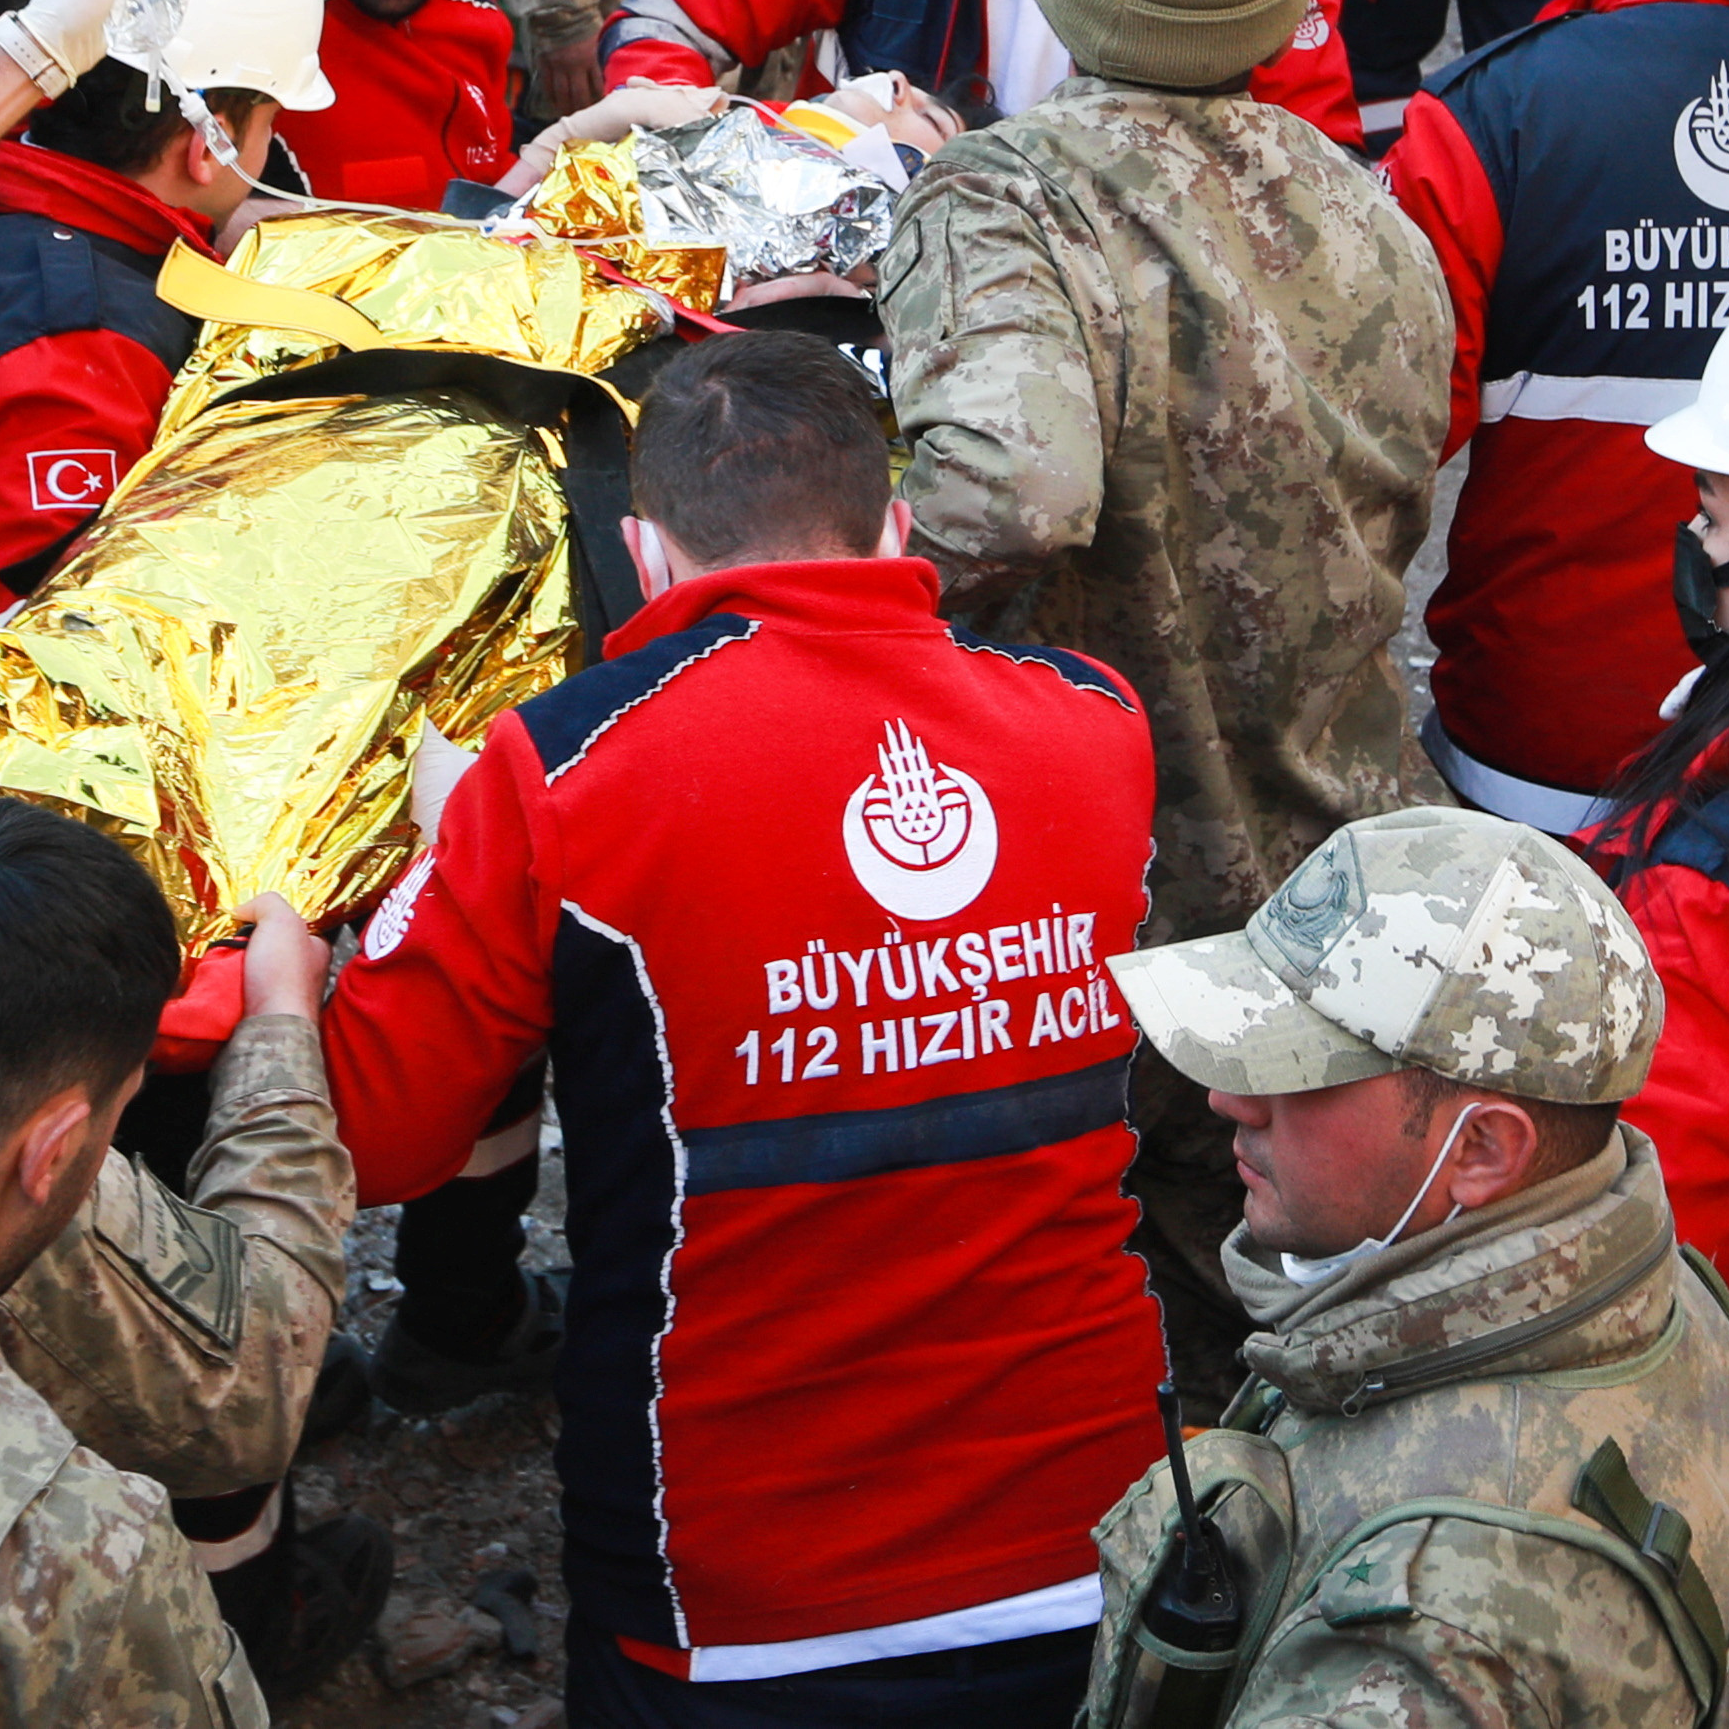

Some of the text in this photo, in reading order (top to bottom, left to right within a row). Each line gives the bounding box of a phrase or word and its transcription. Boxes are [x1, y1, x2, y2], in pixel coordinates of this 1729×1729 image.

[1567, 282, 1651, 331] 112
[764, 902, 1098, 1015] BÜYÜKŞEHİR
[735, 964, 1121, 1085] 112 HIZIR ACİL
